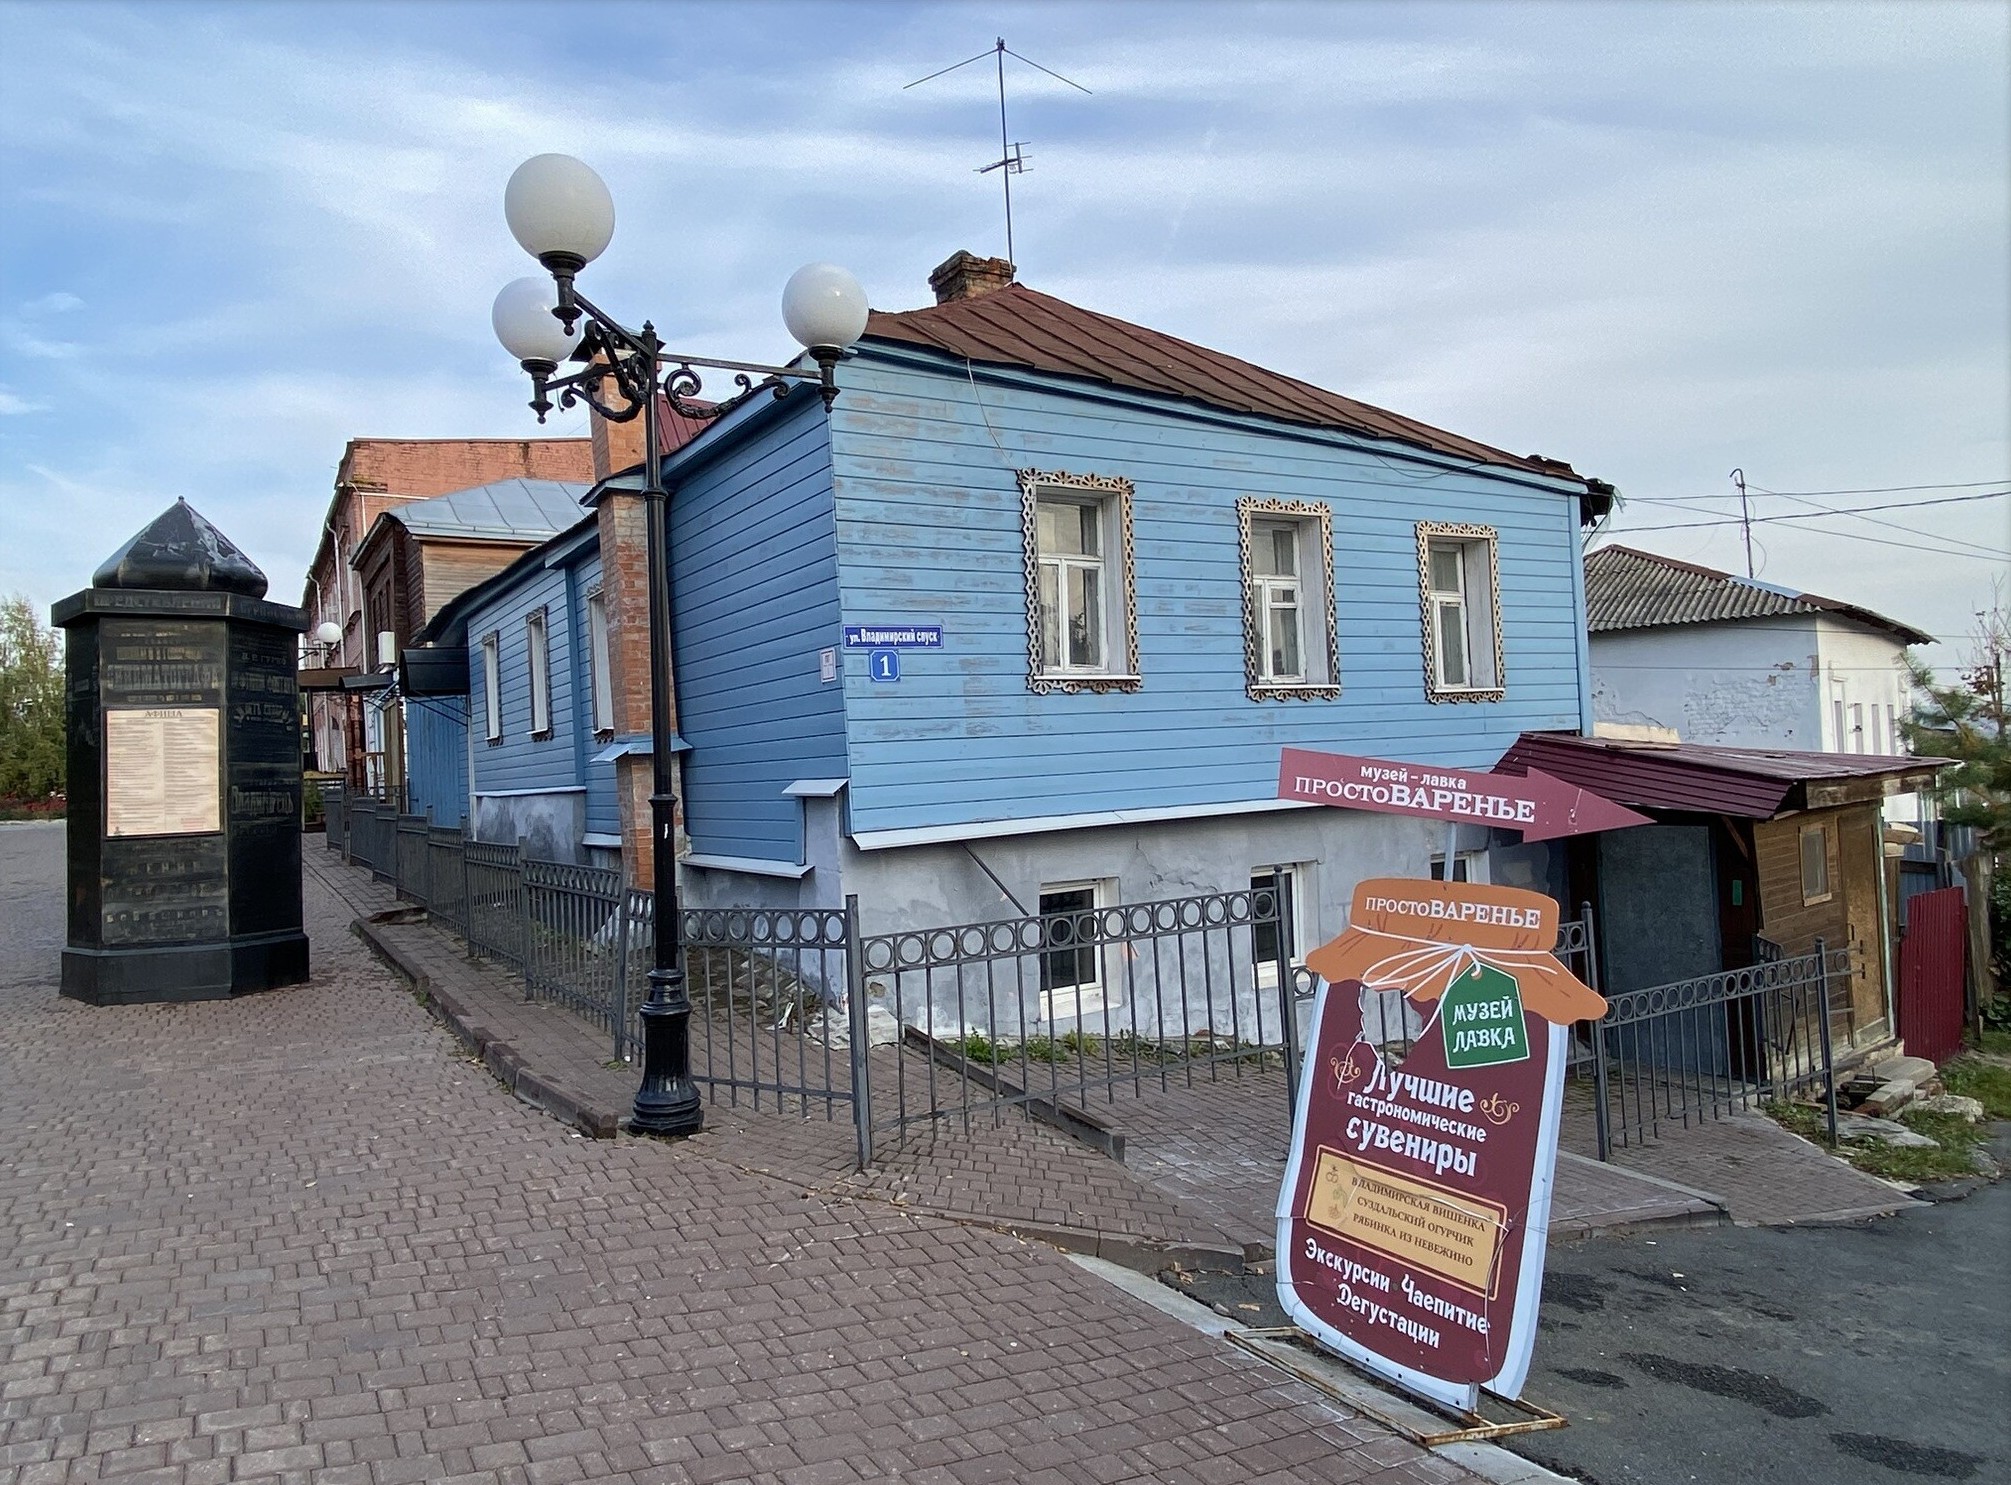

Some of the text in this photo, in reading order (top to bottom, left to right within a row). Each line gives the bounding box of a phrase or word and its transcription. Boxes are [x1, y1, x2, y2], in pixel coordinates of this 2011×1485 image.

[849, 628, 938, 646] ул. Владимирский спуск
[880, 655, 892, 677] 1
[1452, 996, 1513, 1025] МУЗЕЙ
[1452, 1027, 1515, 1053] ЛАВКА
[1362, 1059, 1475, 1113] Лучшие
[1347, 1091, 1487, 1143] гастрономические
[1346, 1116, 1476, 1177] сувениры
[1351, 1176, 1486, 1233] ВЛАДИМИРСКАЯ ВИШЕНКА
[1356, 1195, 1475, 1248] СУЗДАЛЬСКИЙ ОГУРЧИК
[1352, 1213, 1473, 1267] РЯБИНКА ИЗ НЕВЕЖИНО
[1305, 1238, 1491, 1335] Экскурсии Чаепитие
[1337, 1282, 1441, 1348] Дегустации
